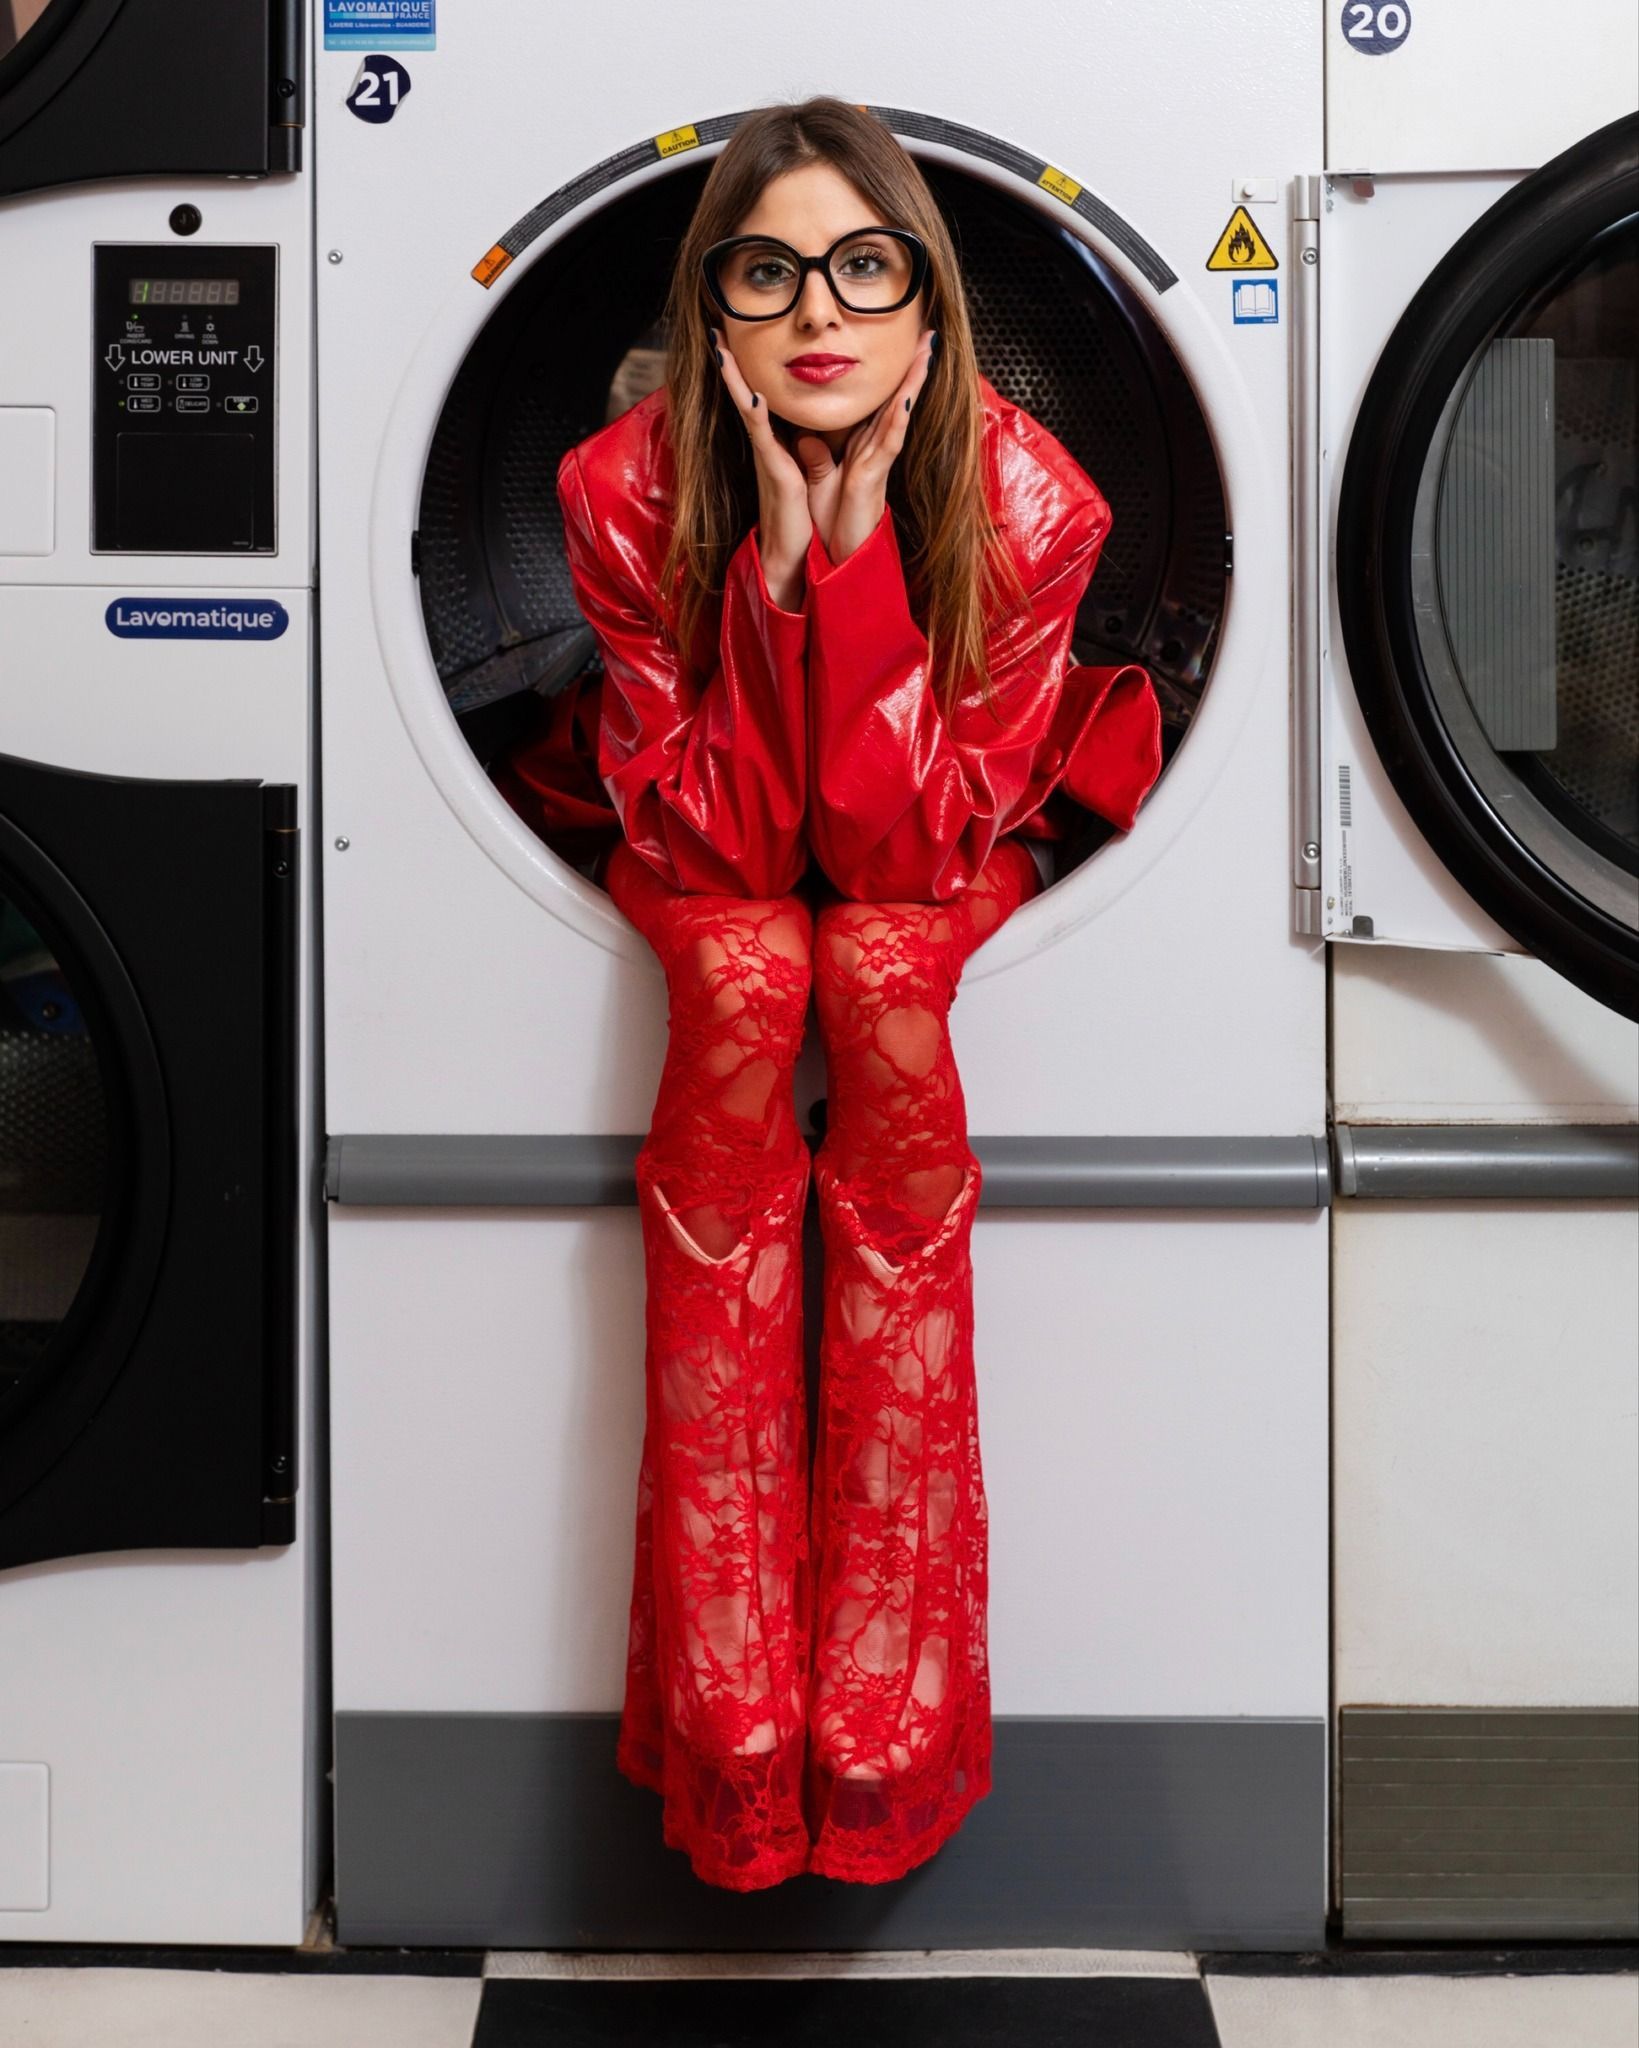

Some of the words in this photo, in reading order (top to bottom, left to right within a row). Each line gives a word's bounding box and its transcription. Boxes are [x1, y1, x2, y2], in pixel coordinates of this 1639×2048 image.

[329, 2, 430, 12] LAVOMATIQUE
[1348, 3, 1407, 38] 20
[355, 71, 399, 107] 21
[661, 137, 696, 154] CAUTION
[1041, 178, 1072, 201] ATTENTION
[131, 351, 193, 364] LOWER
[198, 351, 239, 365] UNIT
[117, 607, 277, 631] Lavomatique
